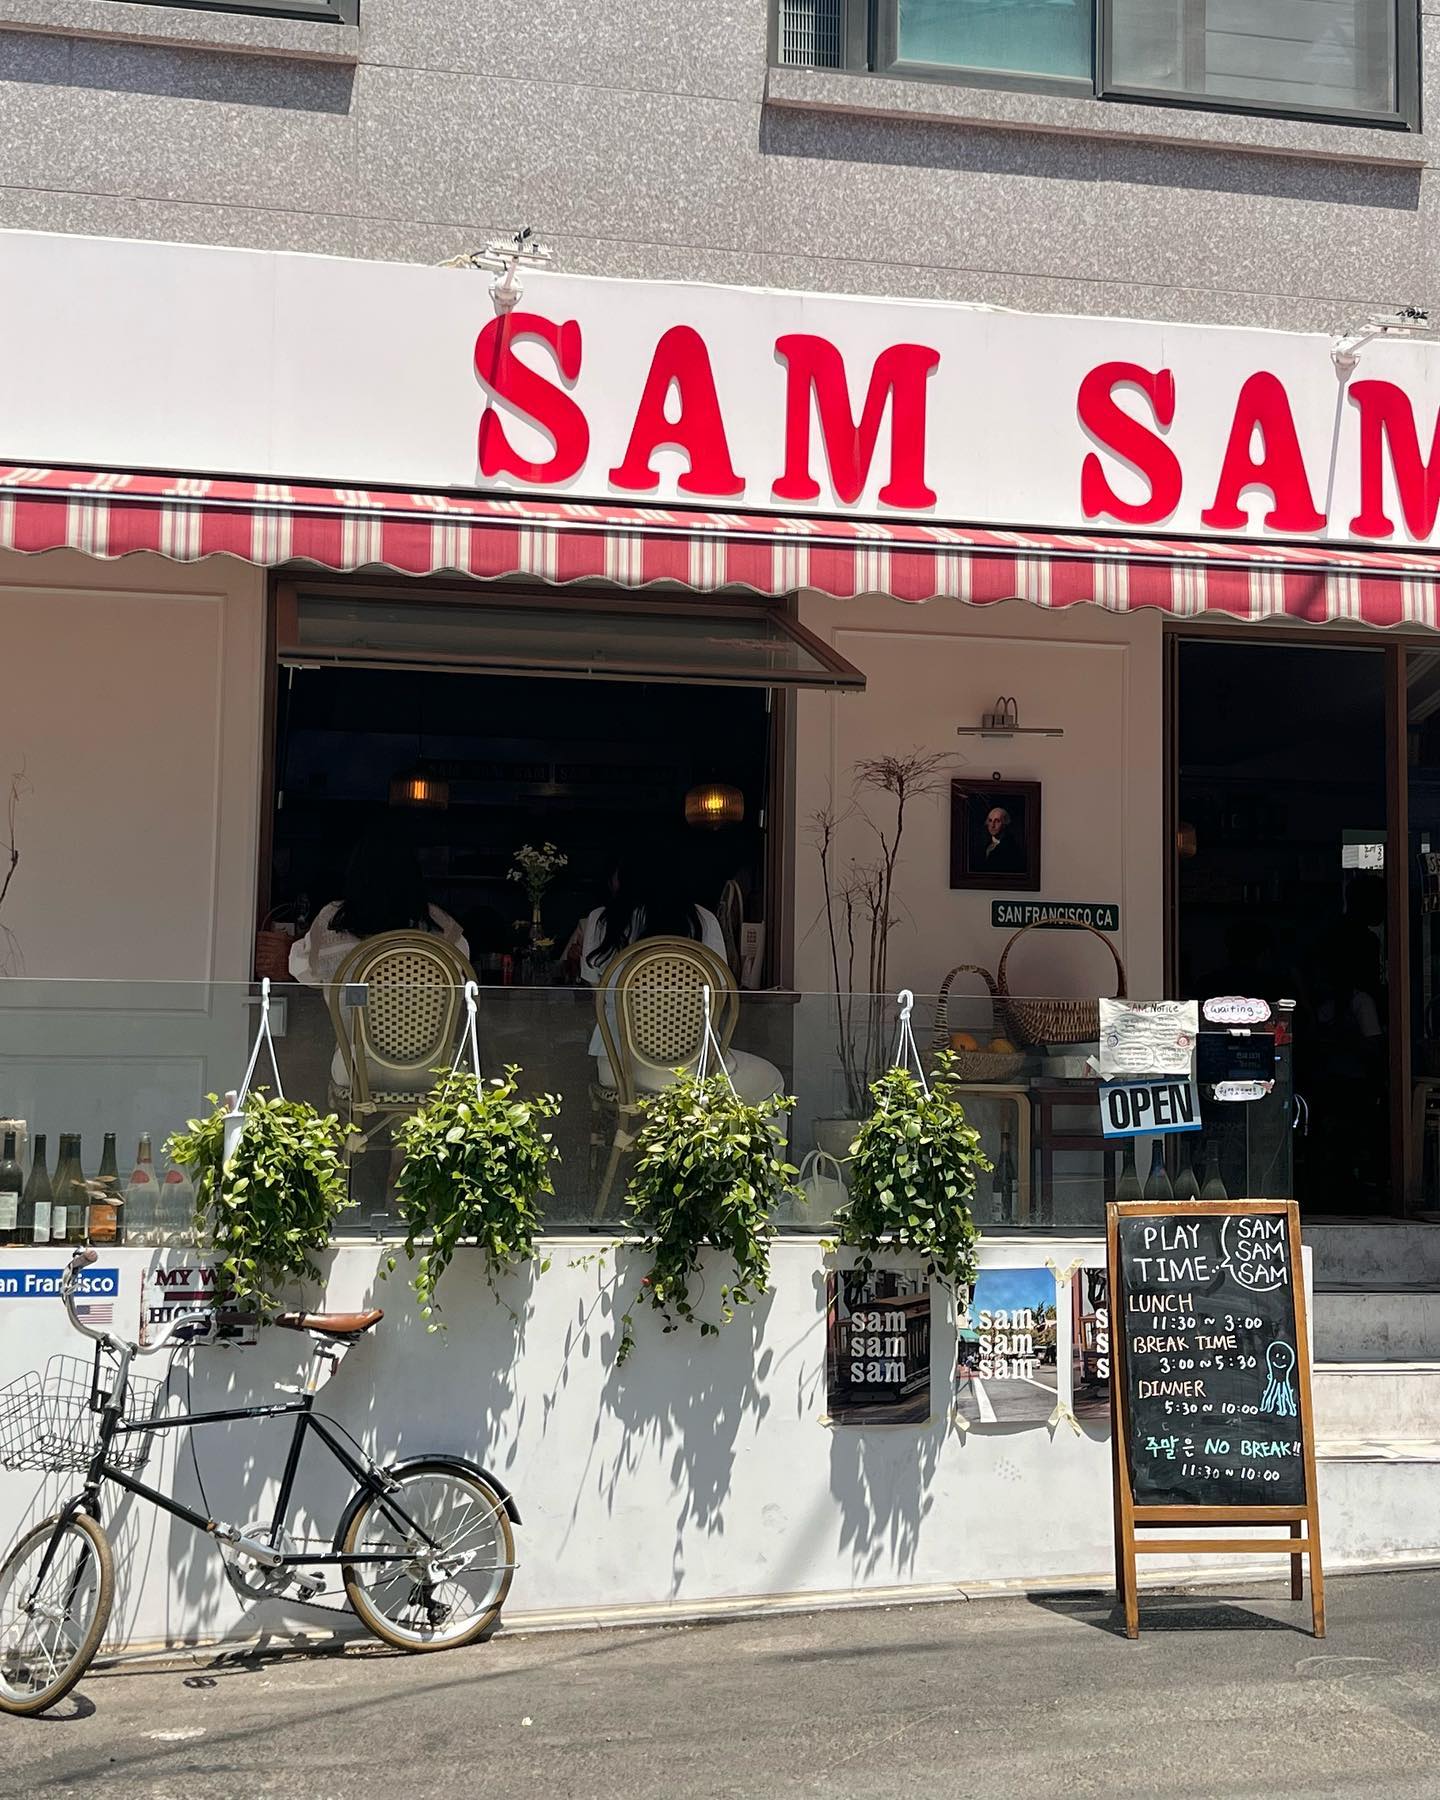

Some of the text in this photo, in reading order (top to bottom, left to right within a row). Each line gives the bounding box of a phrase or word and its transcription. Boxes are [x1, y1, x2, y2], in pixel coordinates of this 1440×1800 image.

[474, 312, 1440, 539] SAM SAM
[998, 905, 1022, 923] SAN
[1096, 909, 1113, 926] CA
[1108, 1083, 1194, 1130] OPEN
[1144, 1223, 1200, 1251] PLAY
[1237, 1218, 1285, 1241] SAM
[1235, 1240, 1285, 1262] SAM
[154, 1269, 193, 1286] MY
[1132, 1255, 1210, 1283] TIME
[1238, 1263, 1288, 1285] SAM
[0, 1274, 114, 1293] an Franisco
[1129, 1293, 1194, 1314] LUNCH
[851, 1311, 907, 1333] sam
[979, 1308, 1034, 1331] sam
[1224, 1314, 1263, 1332] 3:00
[851, 1336, 907, 1358] sam
[979, 1333, 1034, 1355] sam
[1133, 1334, 1238, 1354] BREAK TIME
[851, 1361, 907, 1383] sam
[979, 1357, 1034, 1380] sam
[1138, 1380, 1207, 1399] DINNER
[1204, 1438, 1230, 1455] NO
